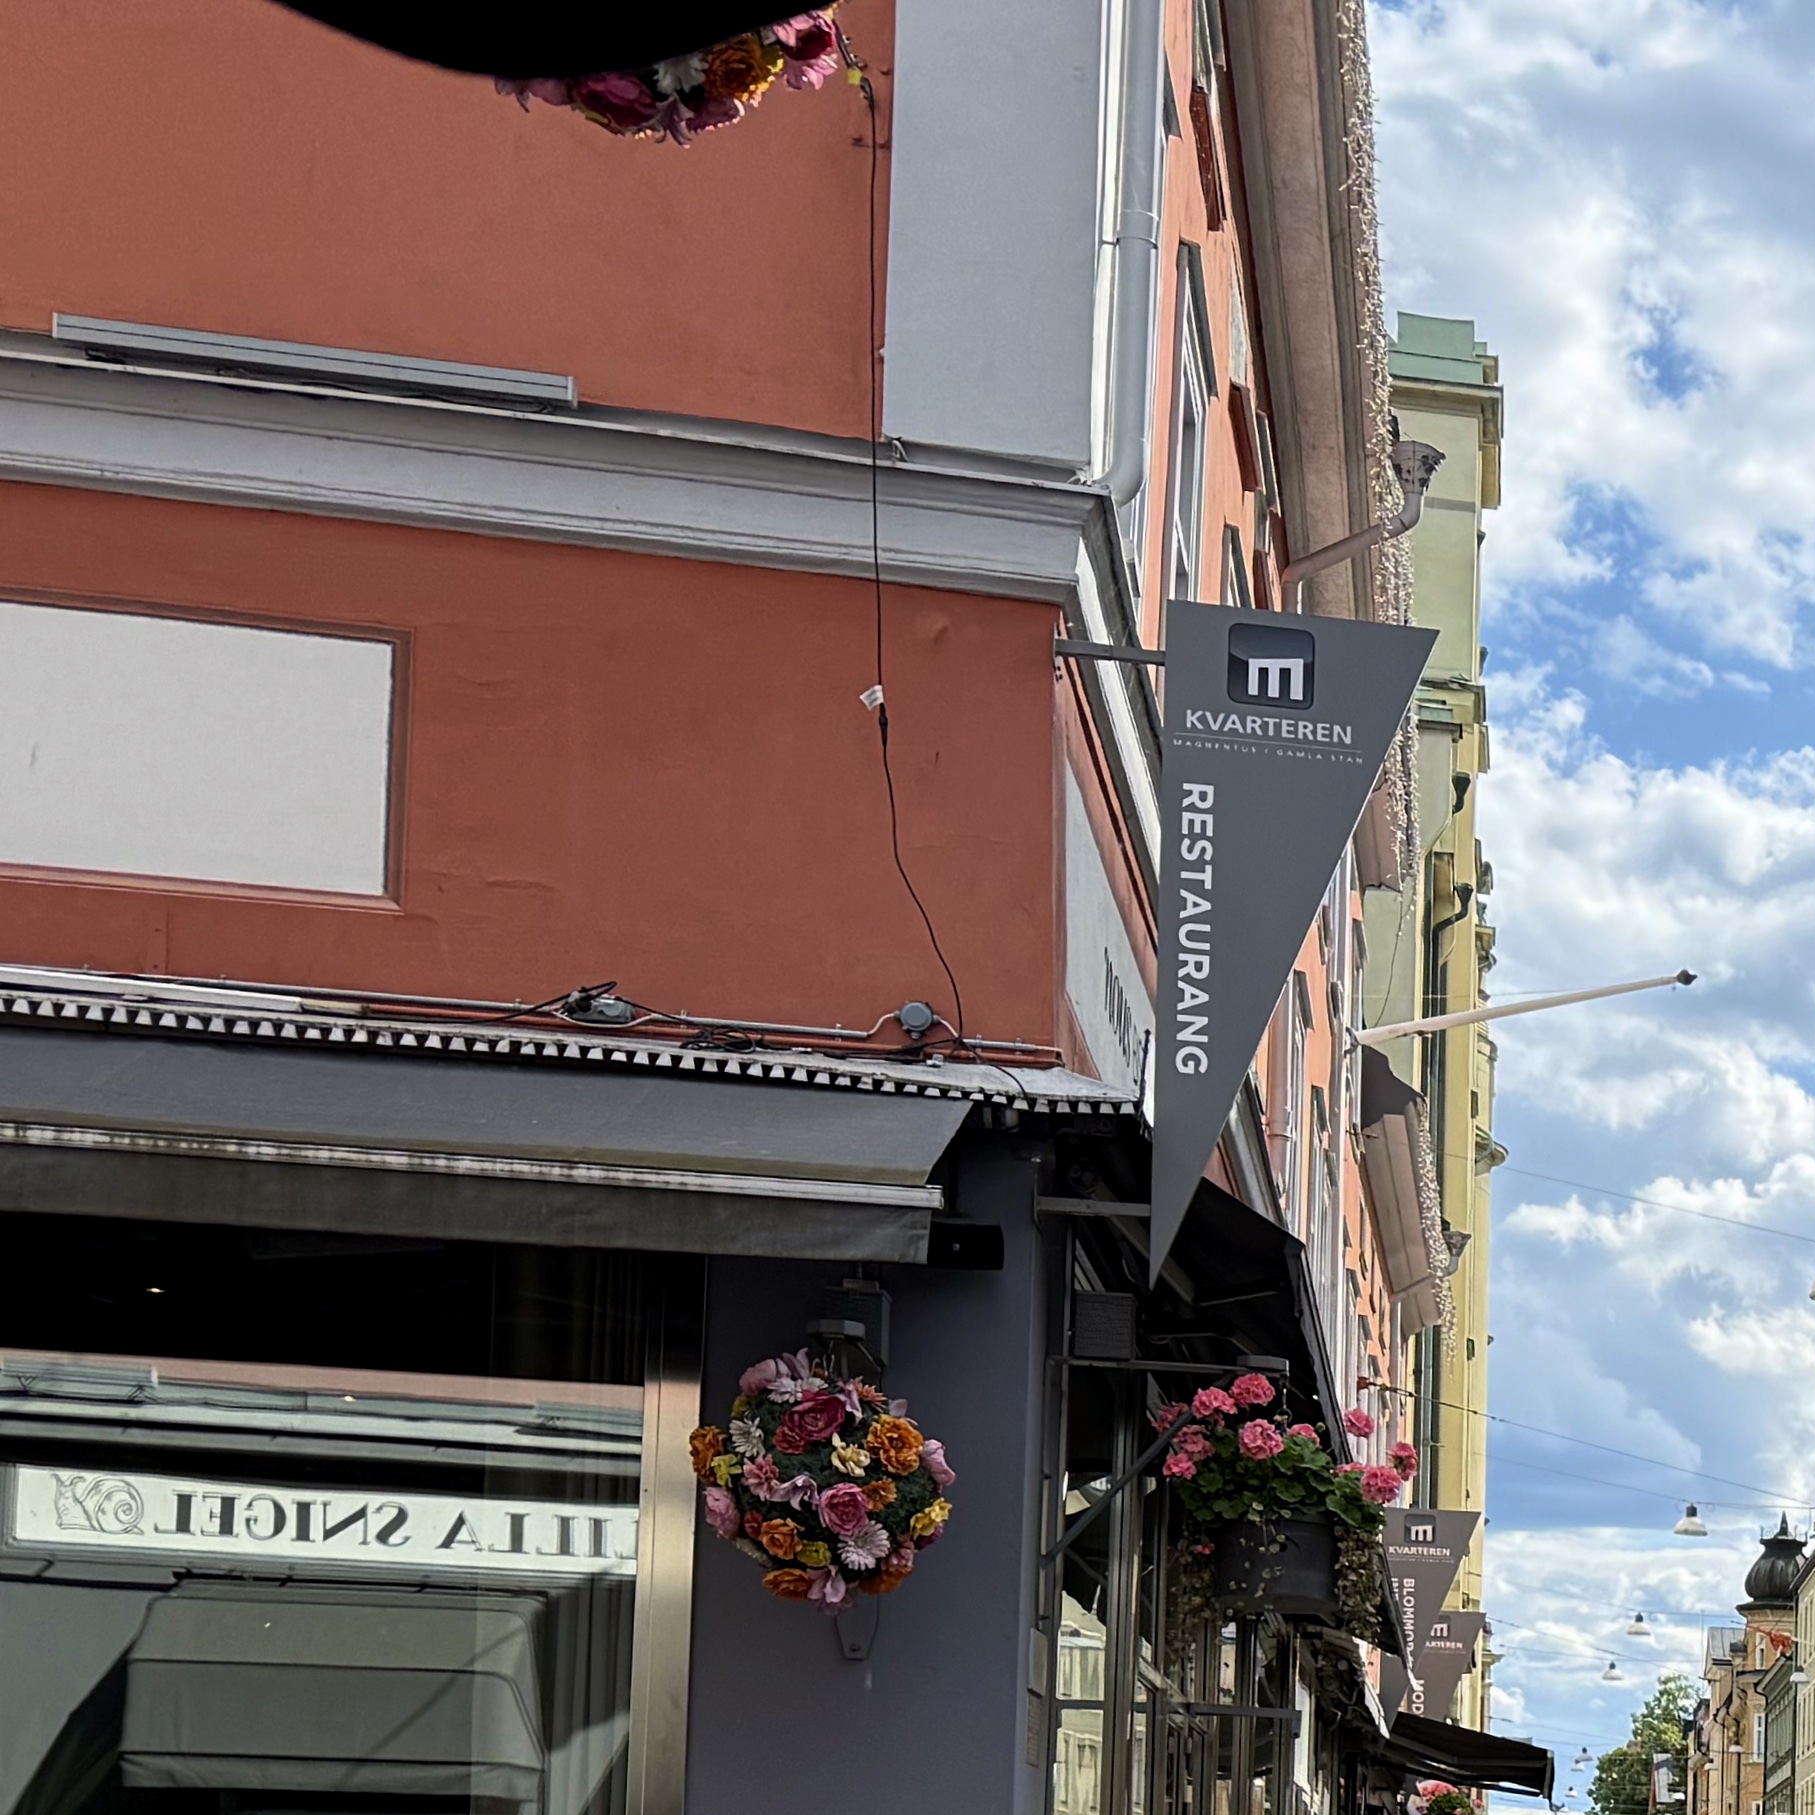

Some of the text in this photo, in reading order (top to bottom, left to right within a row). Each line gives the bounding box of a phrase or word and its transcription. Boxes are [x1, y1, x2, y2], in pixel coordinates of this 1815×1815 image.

[1185, 708, 1352, 745] KVARTEREN
[1175, 782, 1215, 1076] RESTAURANG
[1388, 1545, 1451, 1557] KVARTEREN
[1425, 1641, 1464, 1649] ARTEREN
[1412, 1679, 1425, 1717] MOD
